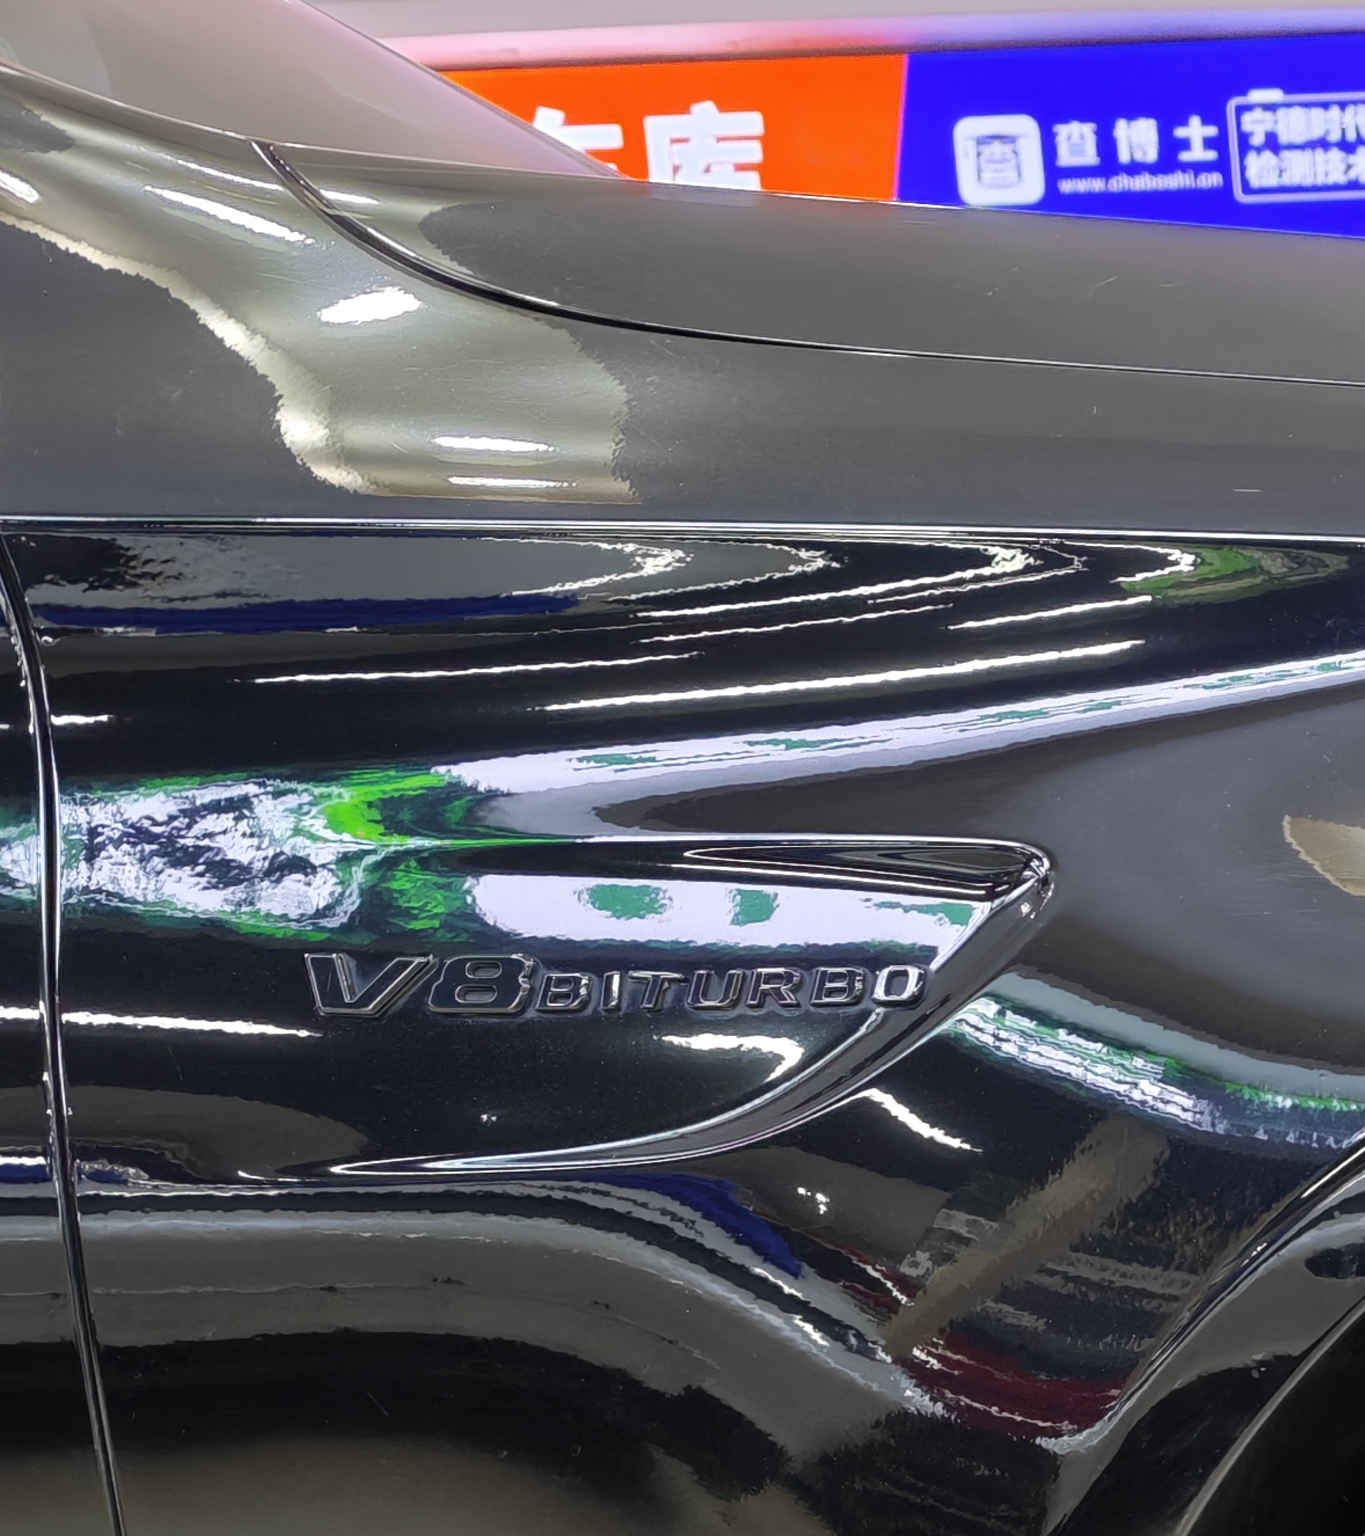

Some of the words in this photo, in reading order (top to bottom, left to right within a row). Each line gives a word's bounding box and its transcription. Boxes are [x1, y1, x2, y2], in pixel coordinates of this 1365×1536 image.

[1052, 115, 1219, 167] 查博士
[1057, 168, 1224, 194] www.chaboshi.cn
[303, 952, 538, 1019] V8
[533, 962, 932, 1015] BITURBO
